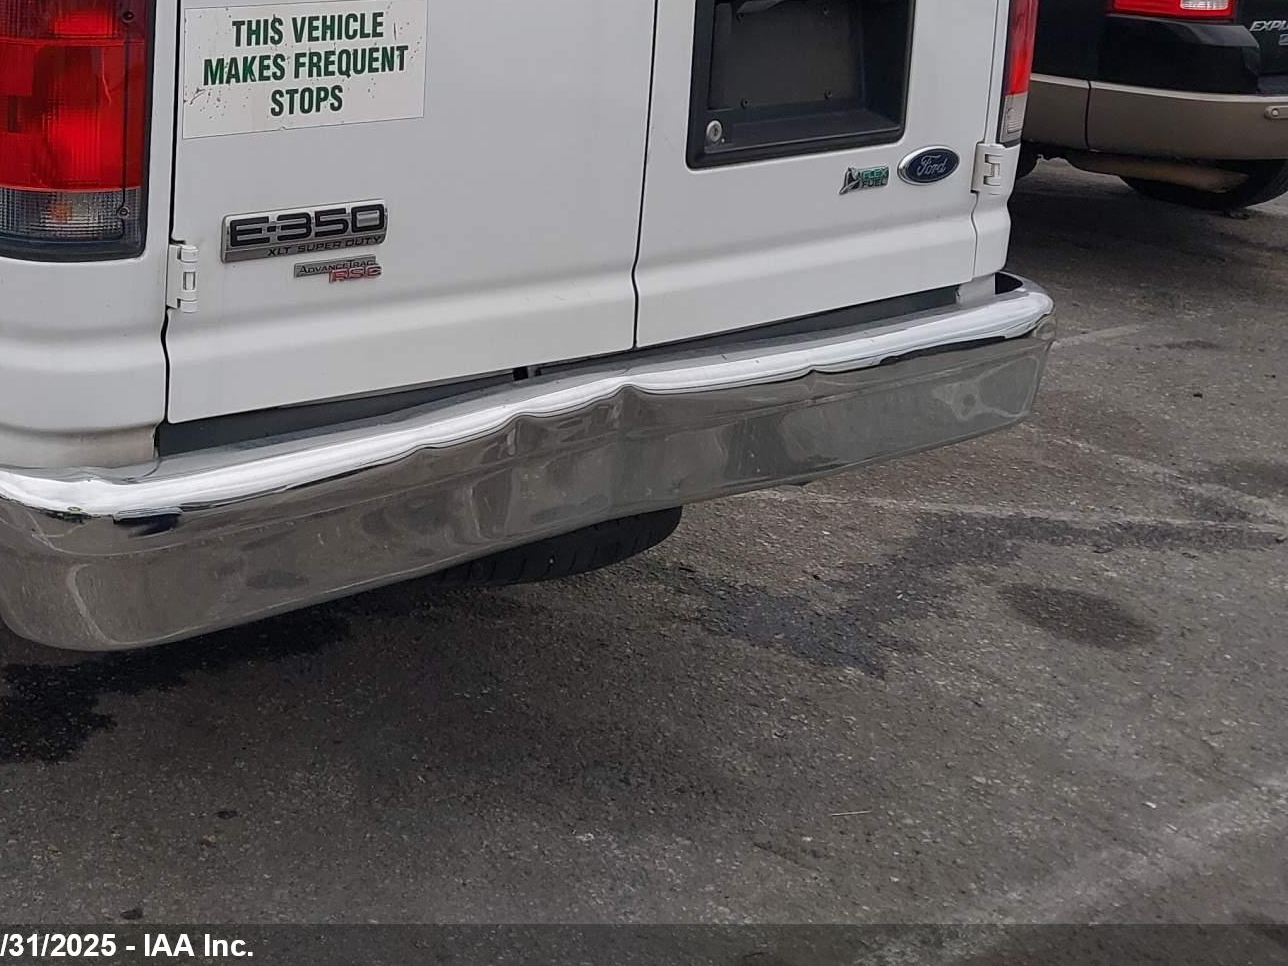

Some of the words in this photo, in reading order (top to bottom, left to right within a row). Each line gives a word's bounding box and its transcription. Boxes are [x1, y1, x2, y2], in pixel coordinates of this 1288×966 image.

[232, 17, 284, 47] THIS
[292, 11, 384, 43] VEHICLE
[203, 53, 286, 86] MAKES
[293, 45, 409, 79] FREQUENT
[270, 85, 343, 116] STOPS
[862, 167, 889, 179] FLEX
[916, 154, 948, 176] Ford
[862, 178, 888, 187] FUEL
[229, 203, 385, 247] E-350
[267, 246, 292, 257] XLT
[297, 240, 341, 253] SUPER
[345, 235, 382, 247] DUTY
[329, 264, 383, 283] RSC
